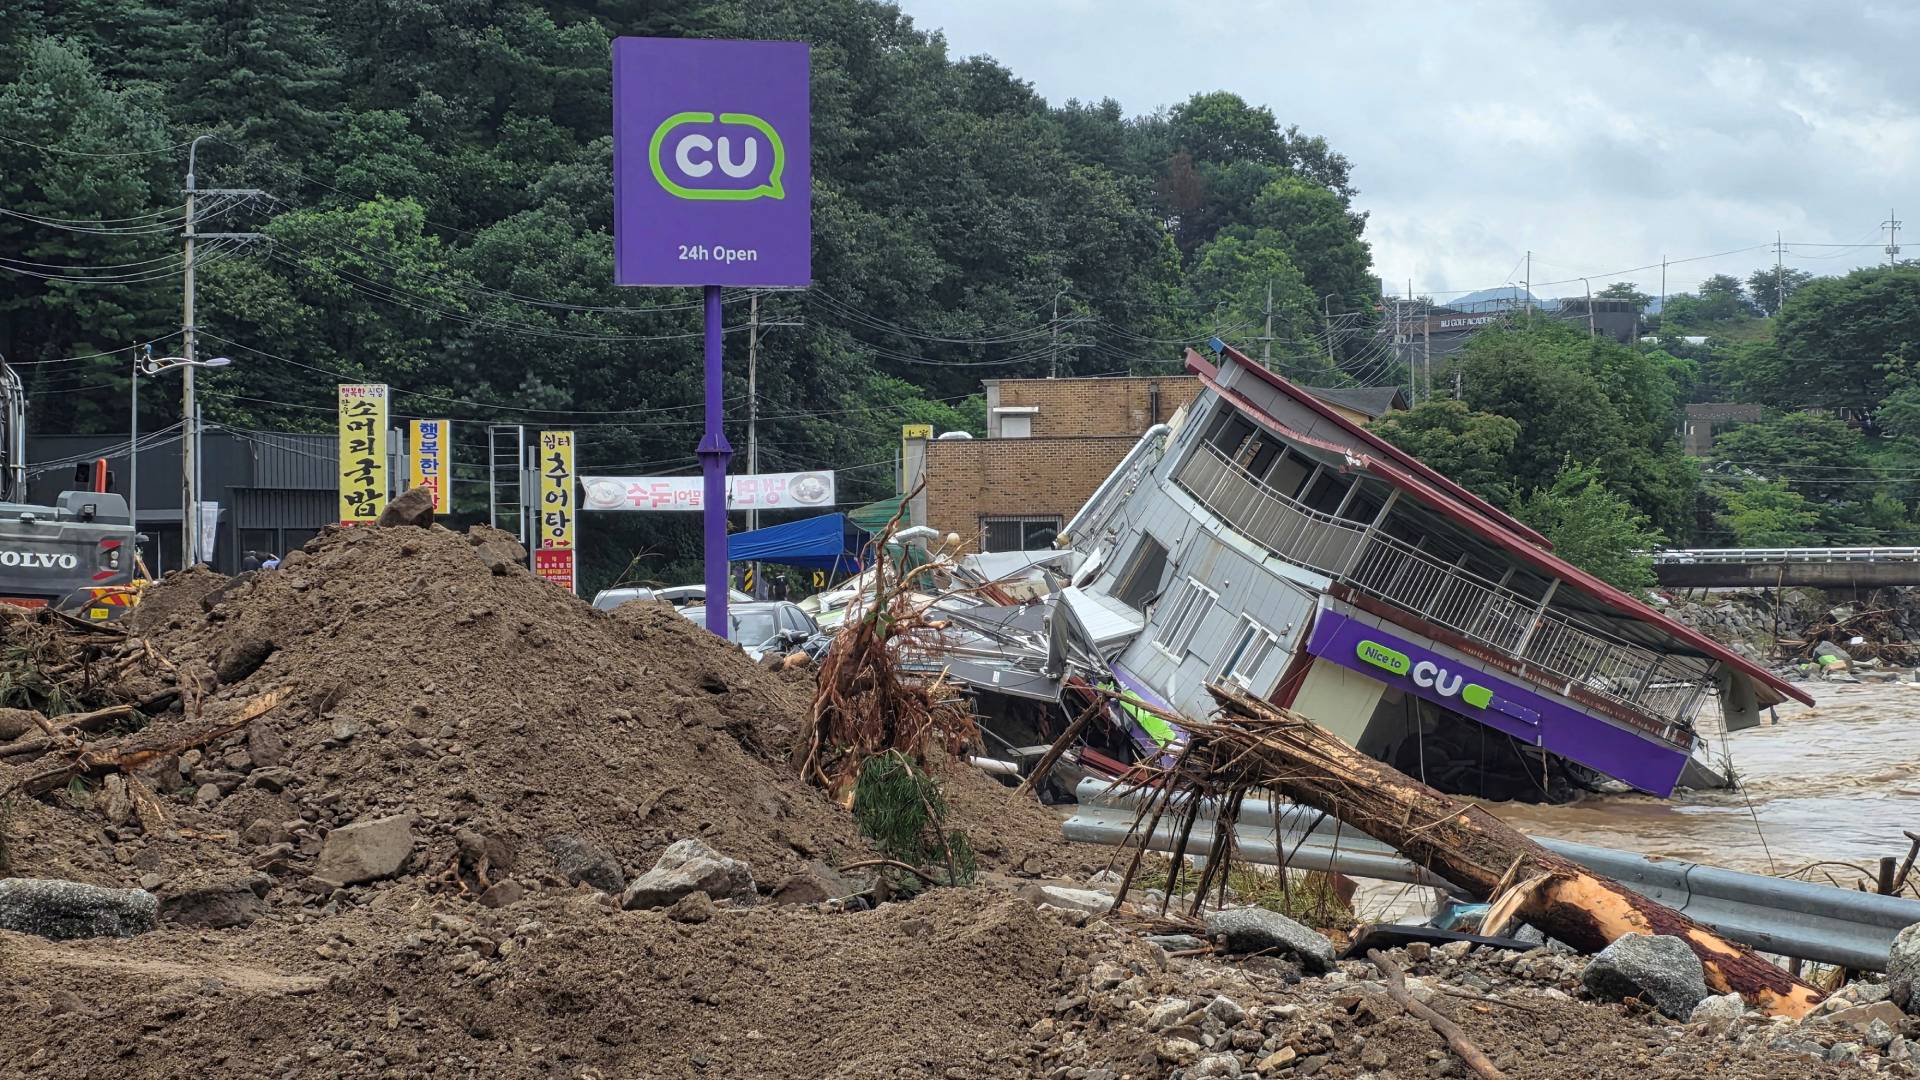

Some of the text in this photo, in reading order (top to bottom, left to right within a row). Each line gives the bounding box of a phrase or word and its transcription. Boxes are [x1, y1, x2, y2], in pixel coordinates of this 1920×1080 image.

[675, 134, 757, 178] CU
[679, 245, 757, 264] 24h Open
[1451, 318, 1467, 326] GOLF
[341, 387, 384, 398] 행복한 식당
[419, 422, 440, 475] 행복한
[544, 434, 570, 450] 쉼터
[343, 401, 383, 517] 소머리국밥
[544, 452, 571, 537] 추어탕
[0, 551, 78, 569] OLVO
[1364, 646, 1463, 697] Nice to CU
